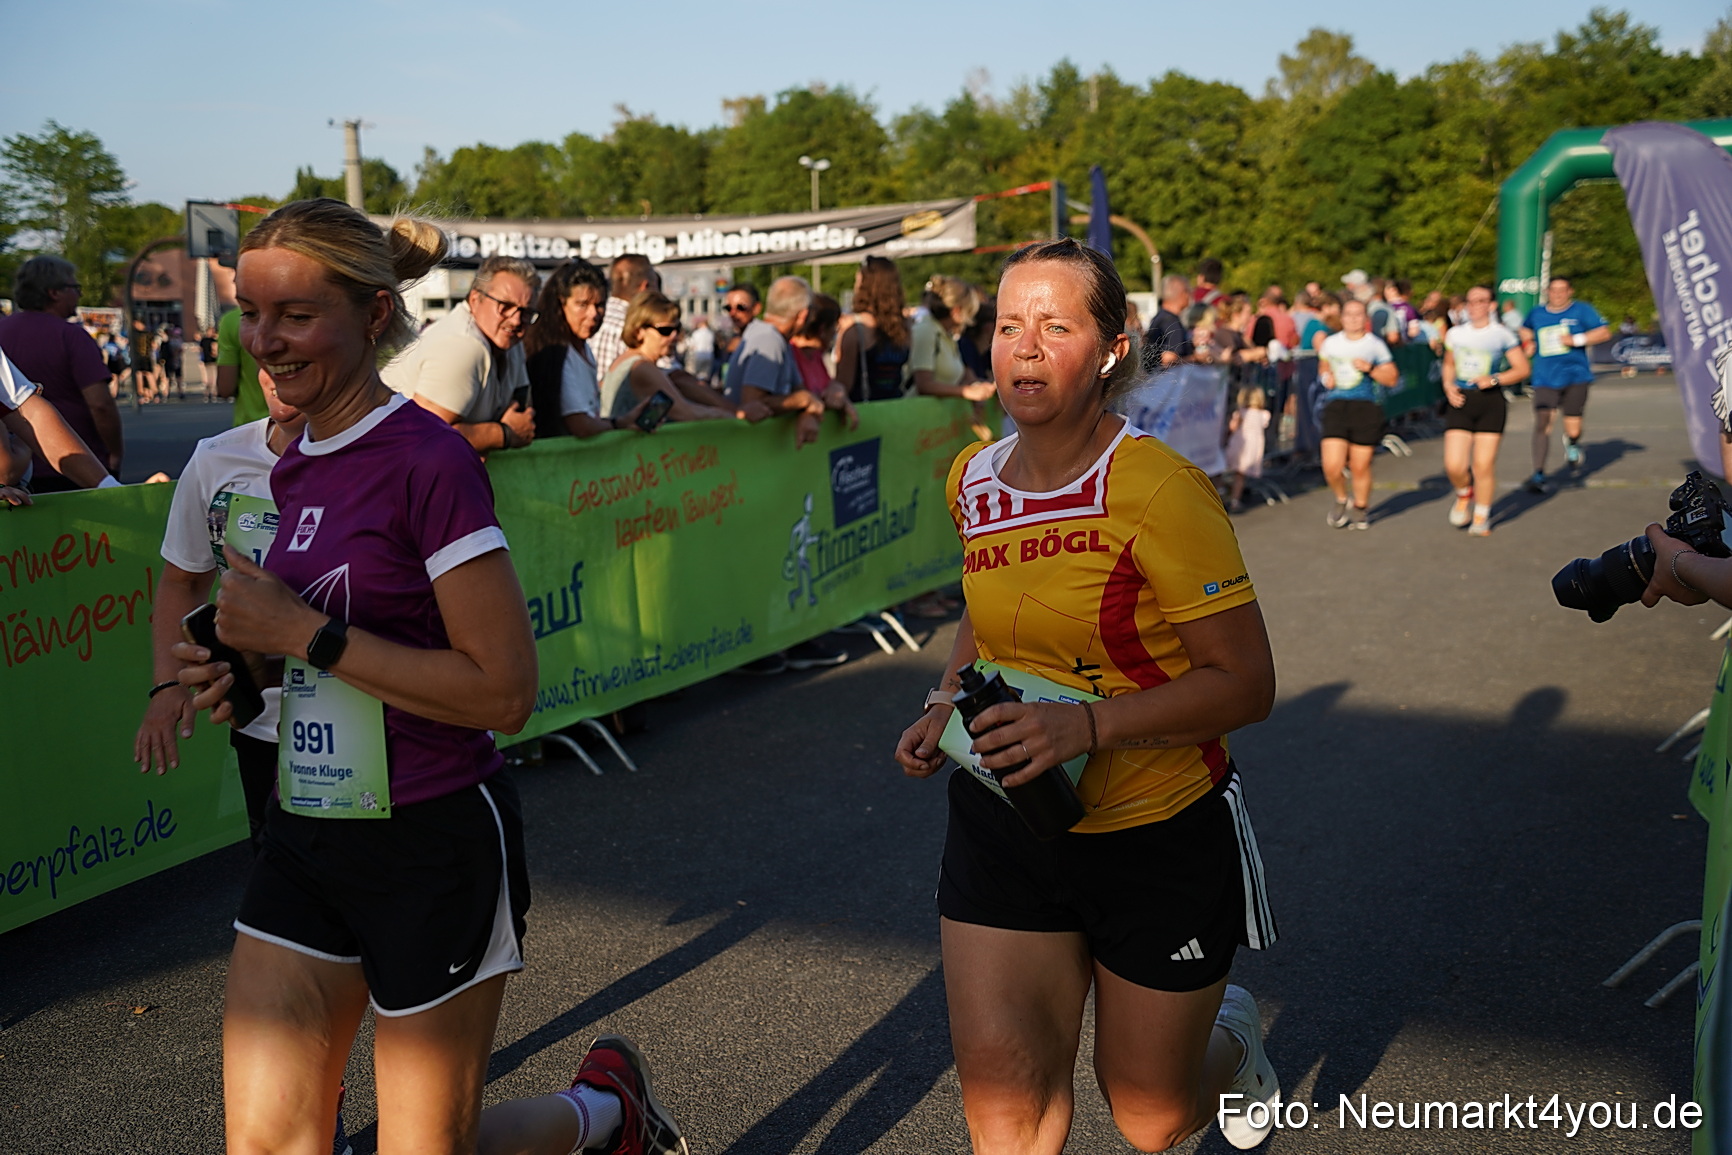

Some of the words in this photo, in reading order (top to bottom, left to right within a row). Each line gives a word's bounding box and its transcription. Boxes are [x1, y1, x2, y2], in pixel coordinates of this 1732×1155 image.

[479, 231, 577, 259] Plätze.
[580, 230, 673, 264] Fertig.
[677, 223, 866, 258] Miteinander.
[212, 499, 228, 508] AOK
[568, 459, 660, 517] Gesunde
[660, 443, 719, 488] Firmen
[297, 526, 316, 534] FUCHS
[615, 505, 679, 549] laufen
[682, 469, 745, 526] länger!
[817, 486, 920, 576] firmenlauf
[0, 531, 115, 591] rmen
[963, 542, 1010, 575] MAX
[1020, 527, 1110, 563] BÖGL
[0, 565, 153, 667] länger!
[292, 719, 335, 755] 991
[289, 760, 318, 777] Yvonne
[319, 763, 353, 781] Kluge
